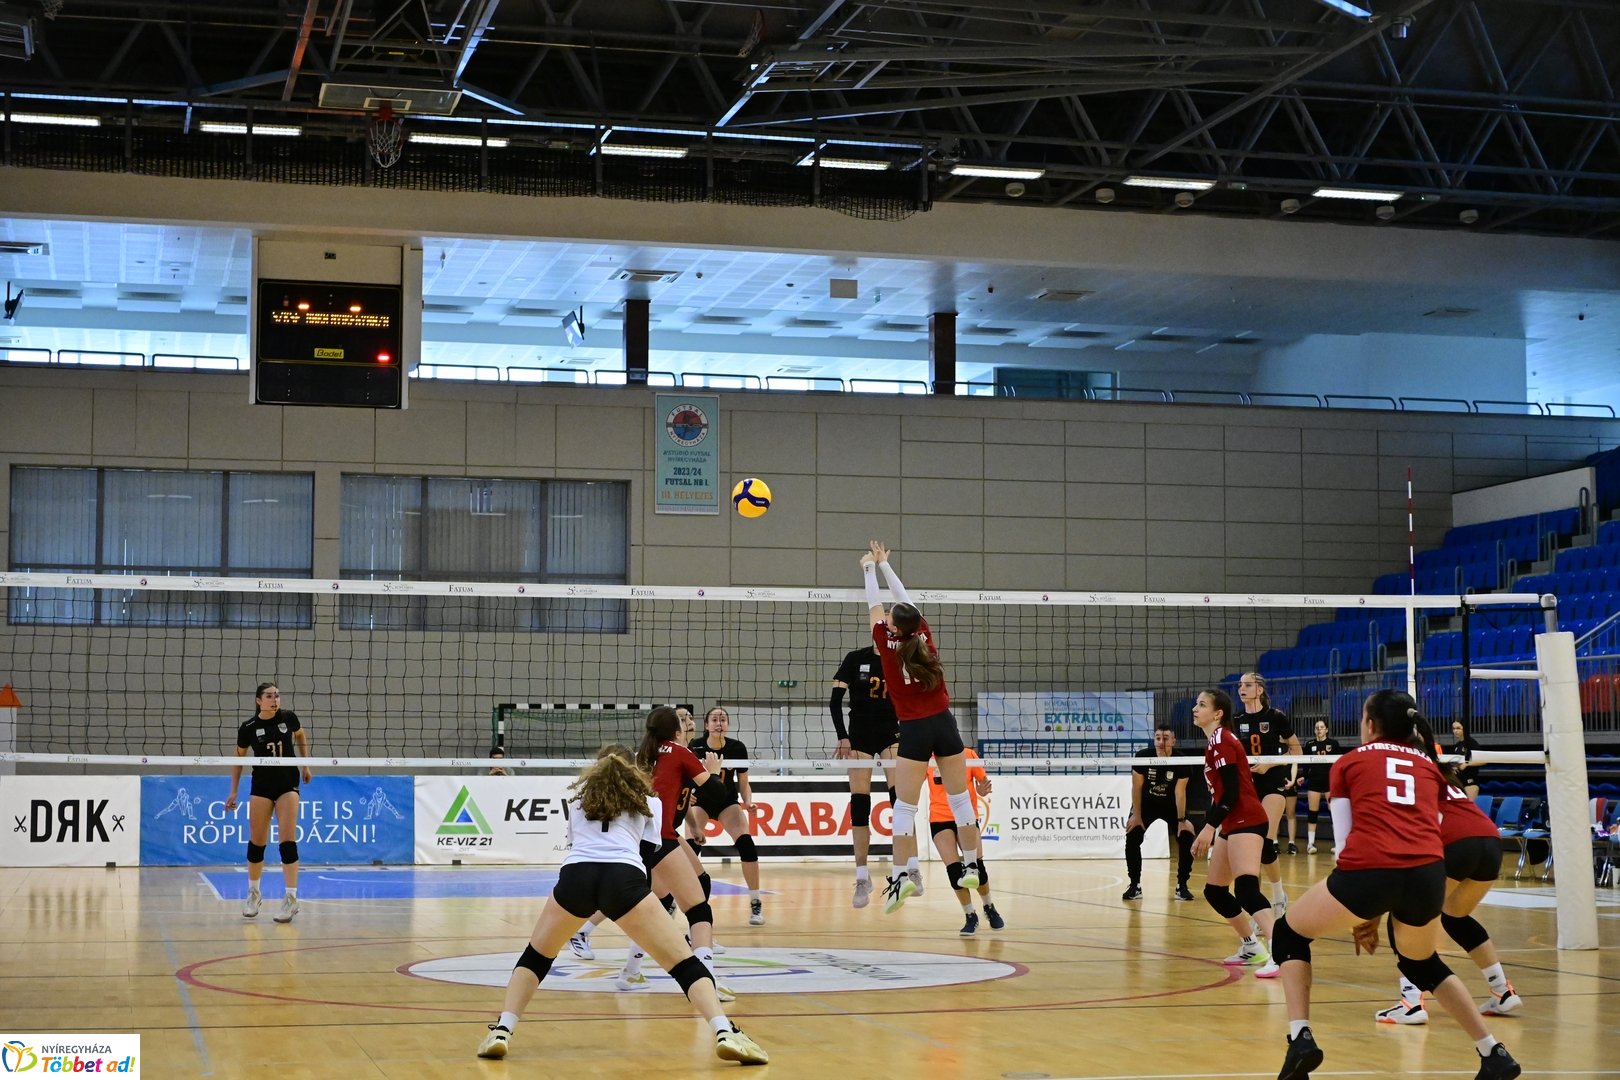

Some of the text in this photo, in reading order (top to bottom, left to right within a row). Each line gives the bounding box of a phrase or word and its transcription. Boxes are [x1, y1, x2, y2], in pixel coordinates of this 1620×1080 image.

[673, 467, 702, 476] 2023/24
[665, 478, 692, 486] FUTSAL
[1044, 712, 1125, 724] EXTRALIGA
[1250, 734, 1261, 755] 8
[1386, 757, 1416, 805] 5
[1010, 793, 1121, 810] NYÍREGYHÁZI
[334, 801, 353, 819] IS
[1011, 817, 1127, 831] SPORTCENTR
[437, 837, 493, 846] KE-VIZ 21
[1012, 834, 1051, 844] Nyíregyházi
[1053, 834, 1101, 844] Sportcentrum
